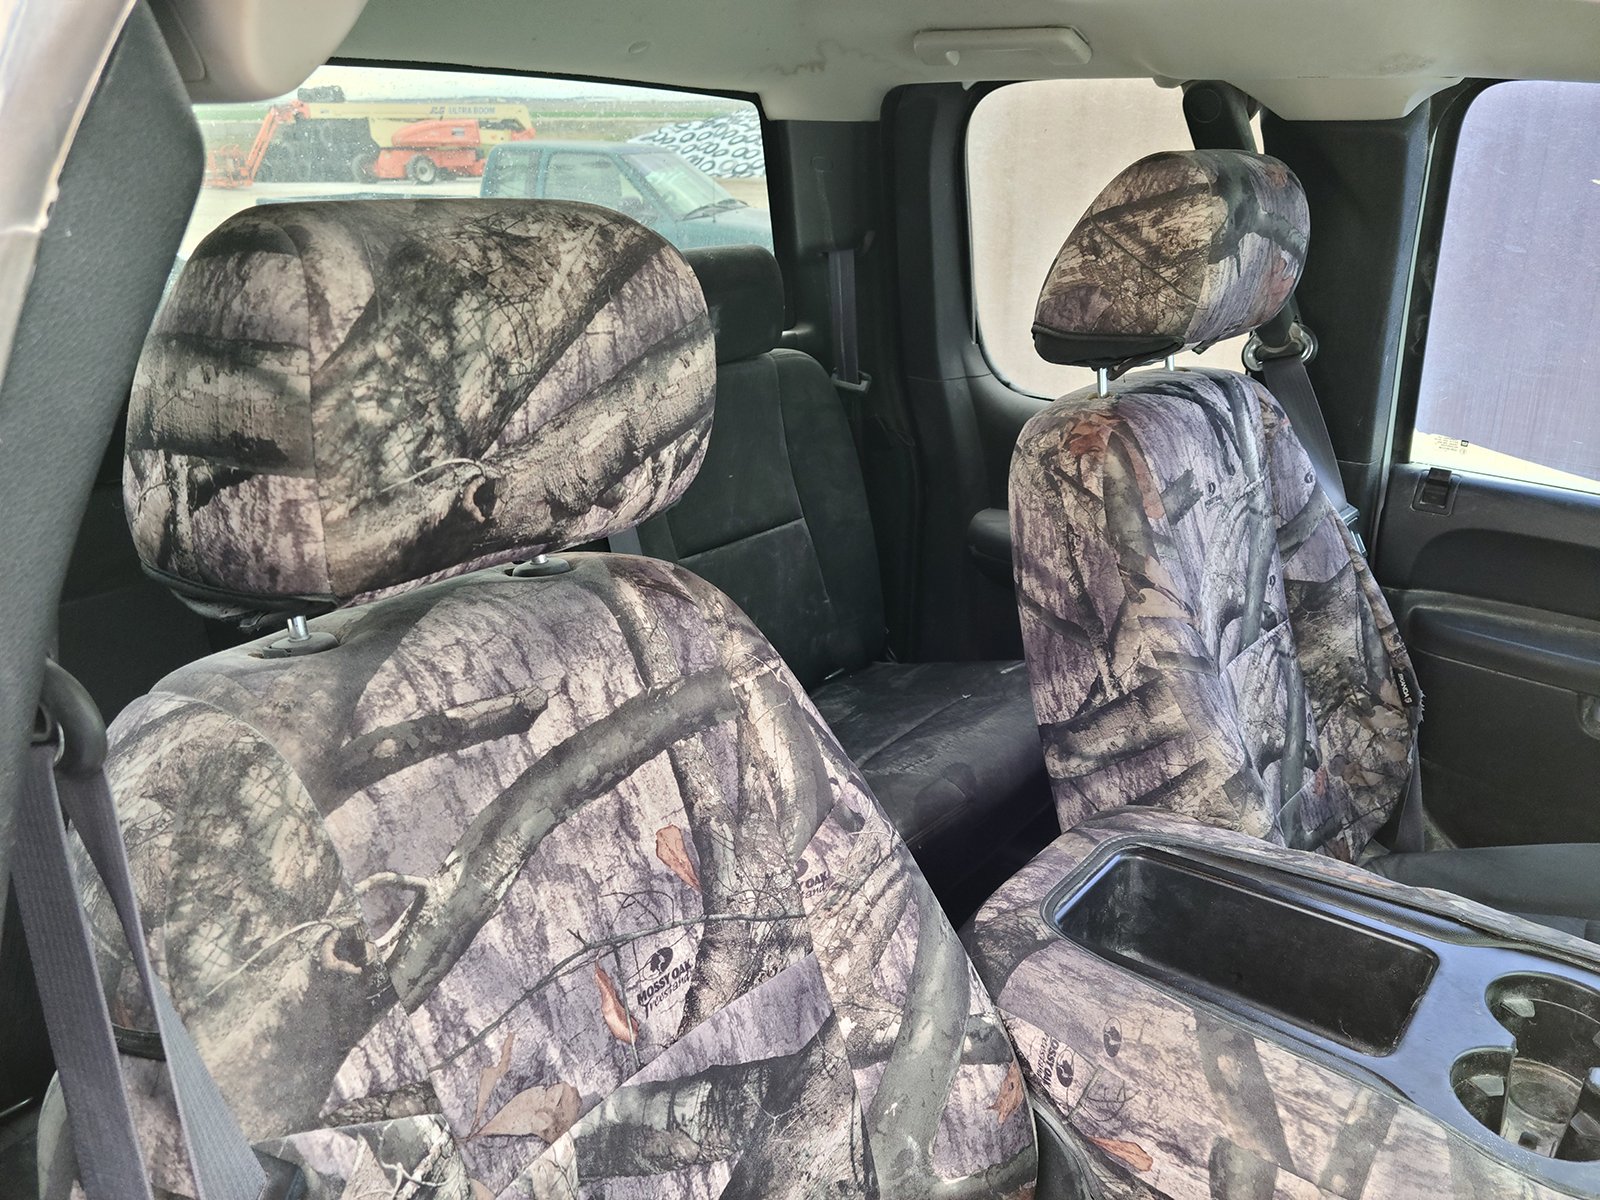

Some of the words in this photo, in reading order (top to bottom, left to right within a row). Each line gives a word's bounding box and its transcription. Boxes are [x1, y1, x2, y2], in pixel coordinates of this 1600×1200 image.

[448, 106, 473, 114] ULTRA
[474, 106, 496, 114] BOOM
[805, 871, 828, 889] OAK
[637, 973, 670, 1006] MOSSY
[671, 959, 692, 980] OAK
[639, 972, 690, 1019] Treestand
[1046, 1038, 1059, 1071] OSSY
